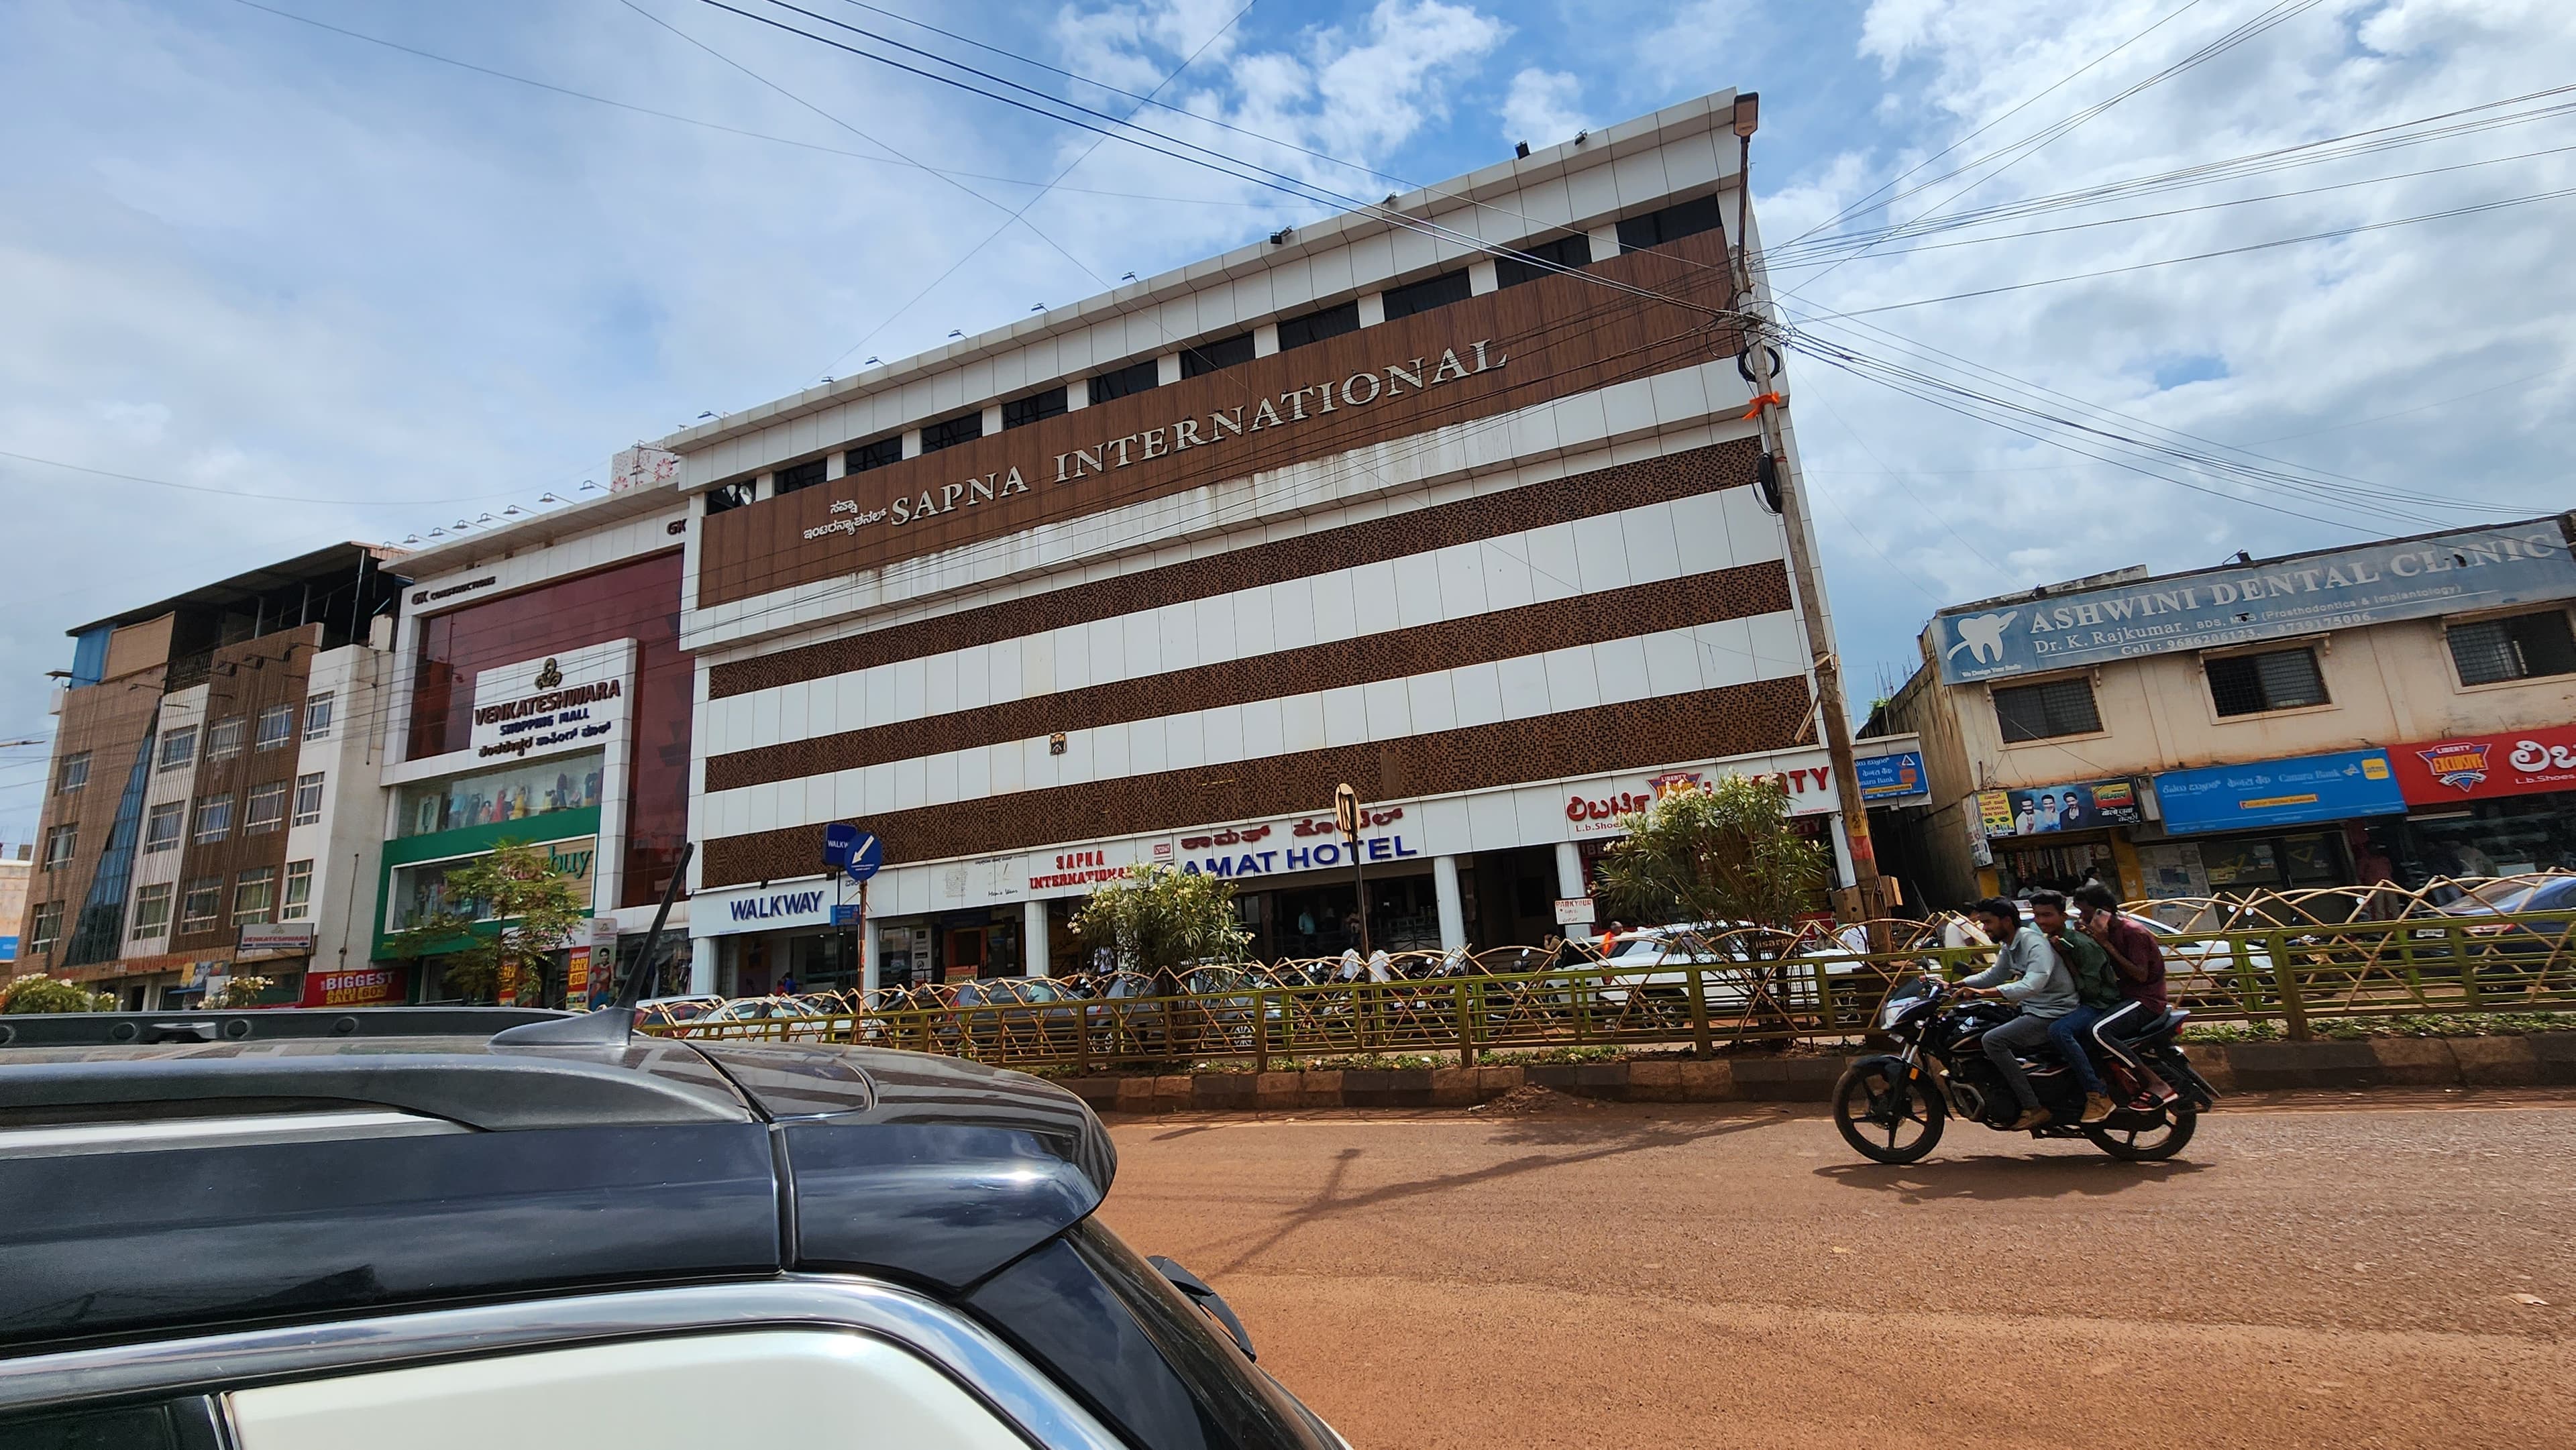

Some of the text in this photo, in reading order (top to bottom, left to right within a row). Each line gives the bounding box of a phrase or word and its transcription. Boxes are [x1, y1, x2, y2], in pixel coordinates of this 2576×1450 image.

[891, 338, 1508, 526] SAPNA INTERNATIONAL
[666, 518, 688, 536] GK
[411, 576, 496, 605] GK CONSTRUCTIONS
[2029, 532, 2557, 634] ASHWINI DENTAL CLINIC
[2033, 639, 2063, 655] Dr.
[2065, 634, 2088, 649] K.
[2361, 597, 2371, 606] &
[2121, 642, 2152, 657] Cell
[474, 679, 621, 726] VENKATESHWARA
[499, 708, 590, 736] SHOPPING MALL
[2436, 744, 2471, 755] LIBERTY
[2432, 752, 2485, 773] EXCLUSIVE
[1660, 774, 1687, 783] LIBERTY
[1877, 776, 1895, 784] Bank
[2278, 769, 2341, 783] Canara Bank
[547, 844, 593, 880] buy
[1055, 850, 1106, 871] SAPNA
[1154, 835, 1417, 880] AMAT HOTEL
[730, 891, 824, 922] WALKWAY
[325, 971, 394, 991] BIGGEST
[326, 994, 357, 1004] SALE
